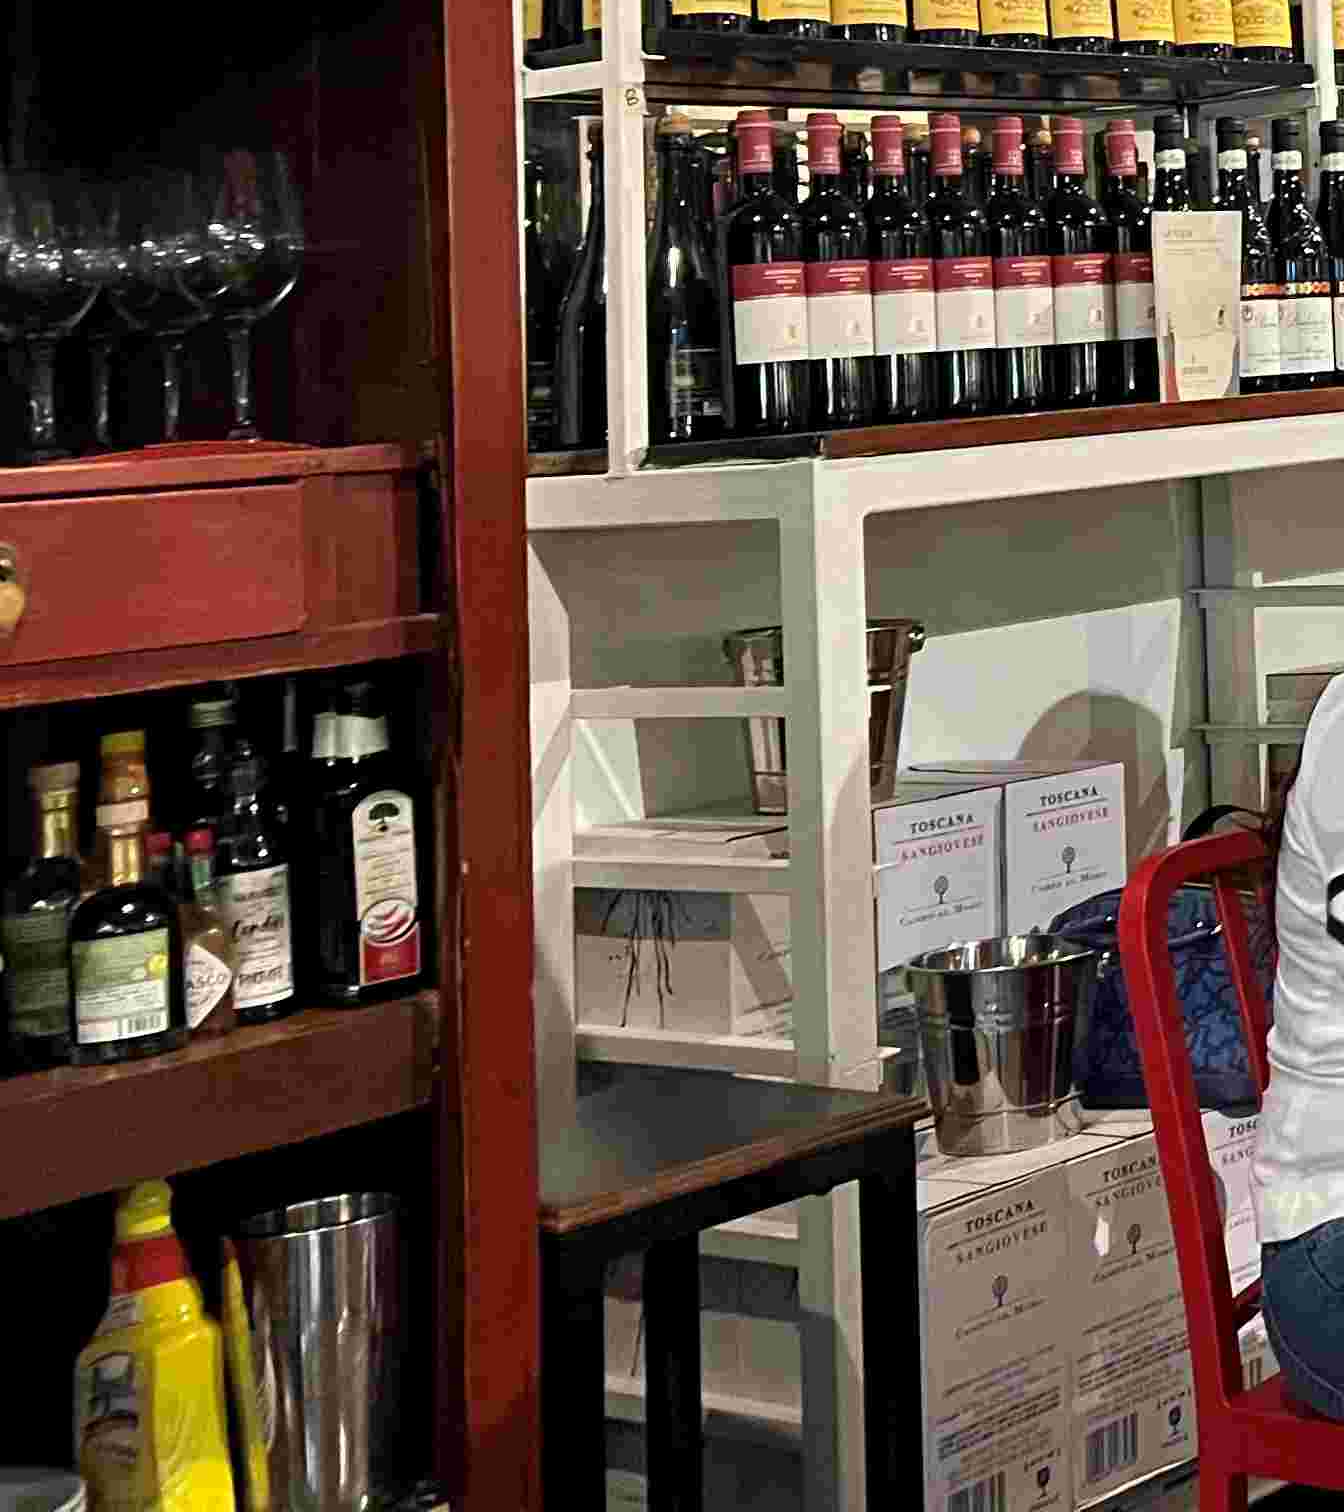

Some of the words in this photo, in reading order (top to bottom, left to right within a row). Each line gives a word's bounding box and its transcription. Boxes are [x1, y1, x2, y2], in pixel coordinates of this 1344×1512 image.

[1040, 785, 1098, 807] TOSCANA
[911, 813, 976, 834] TOSCANA
[1032, 807, 1109, 833] SANGIOVESE
[900, 834, 984, 862] SANGIOVESE
[1103, 1155, 1157, 1183] TOSCAN
[965, 1199, 1035, 1233] TOSCANA
[955, 1220, 1049, 1264] SANGIOVESE
